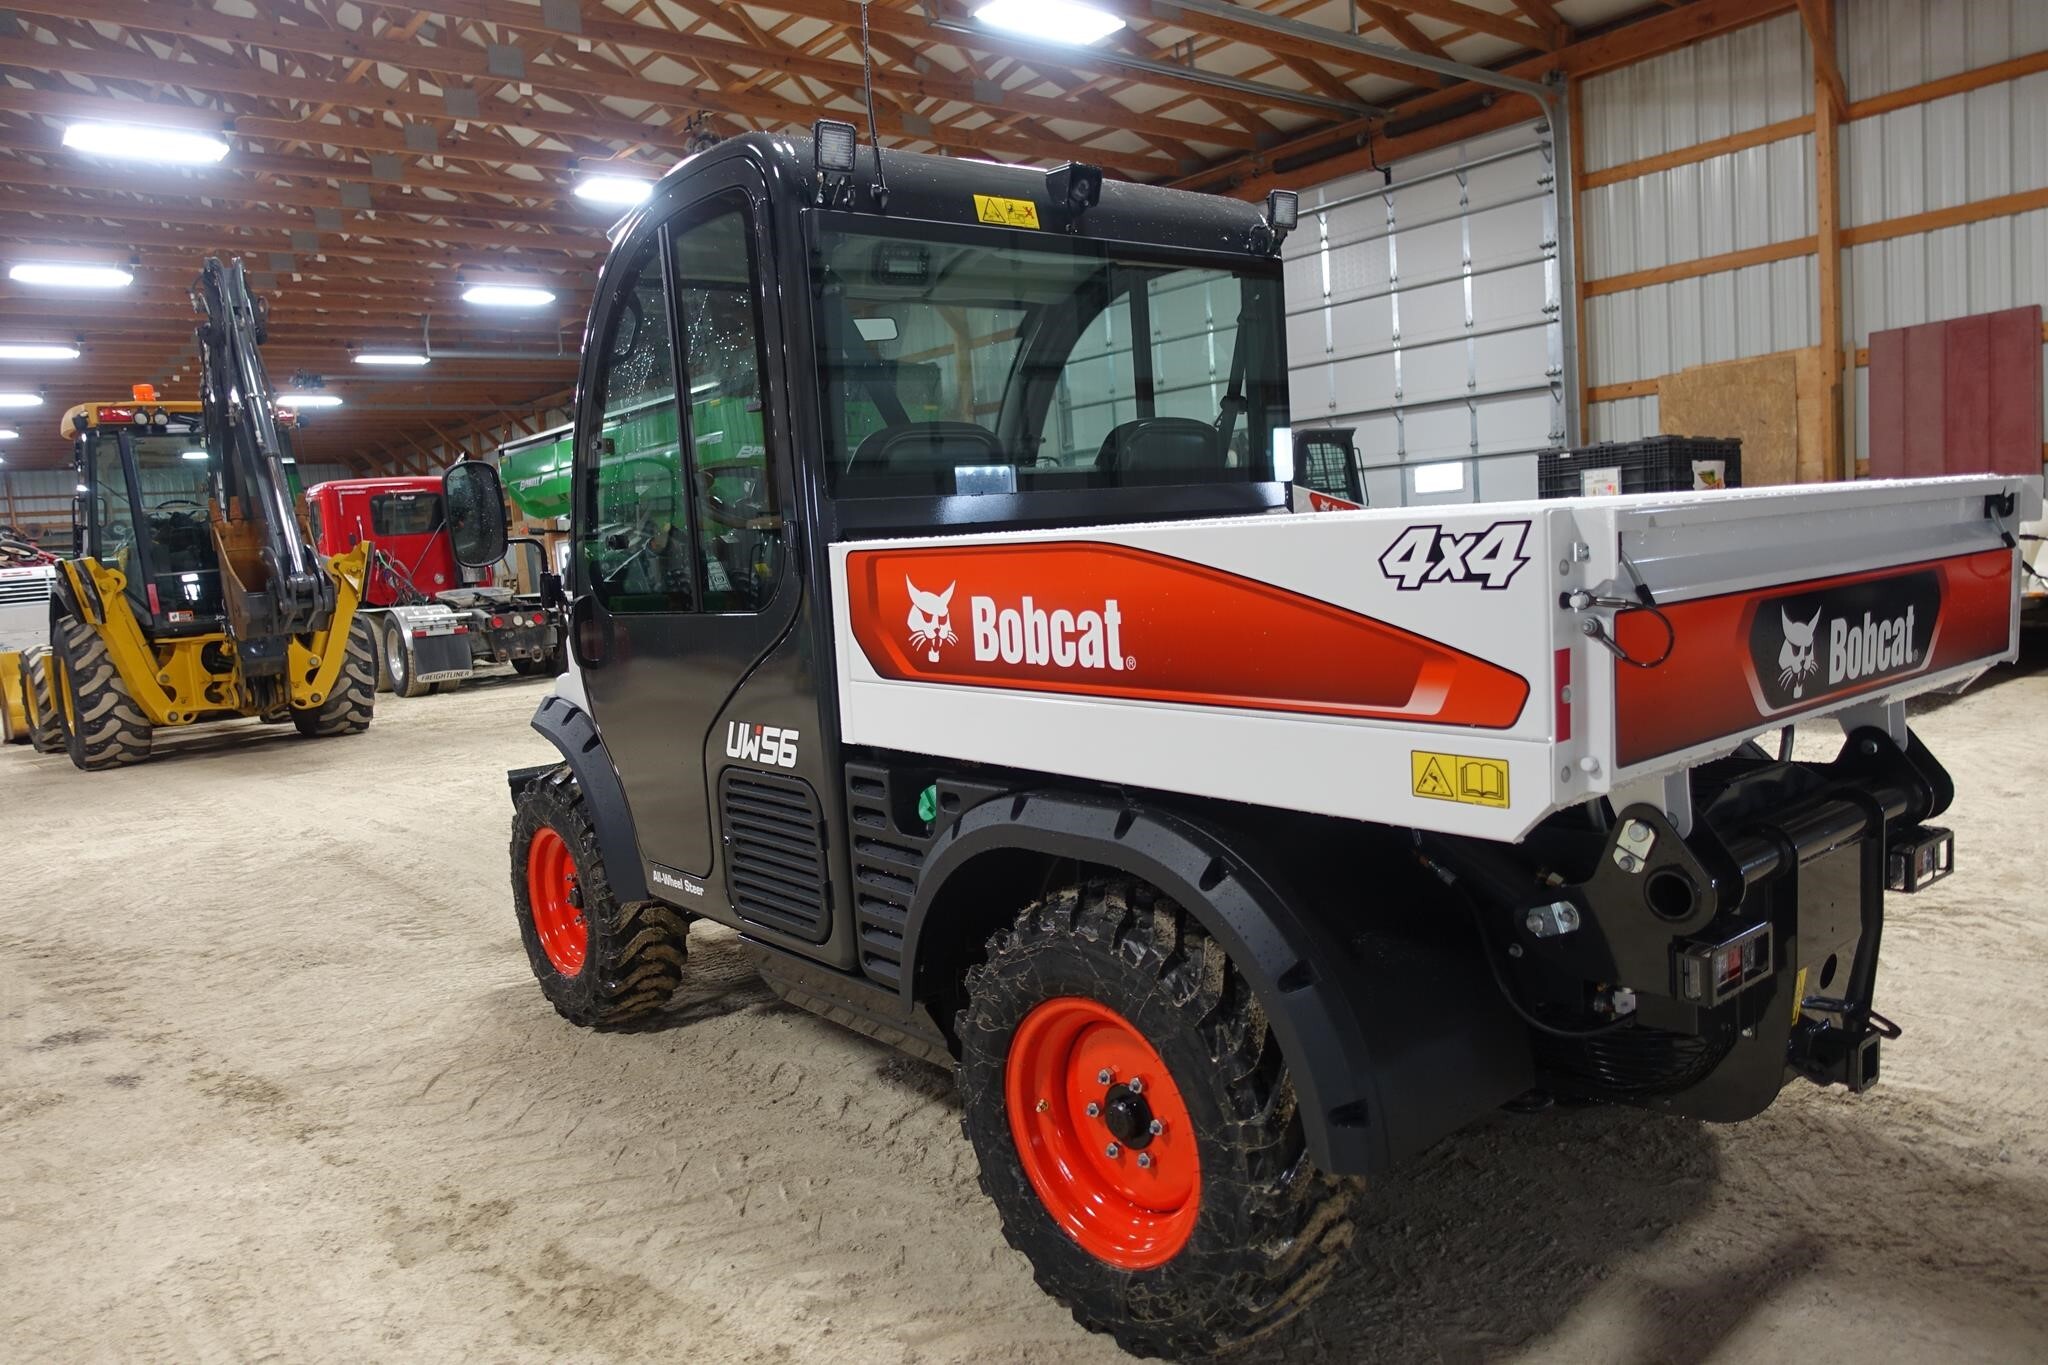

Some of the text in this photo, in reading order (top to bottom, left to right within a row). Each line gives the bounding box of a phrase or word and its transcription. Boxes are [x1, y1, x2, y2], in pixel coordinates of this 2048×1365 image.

[1378, 520, 1532, 591] 4x4
[421, 671, 470, 681] FREIGHTLINER
[653, 870, 705, 896] All-Wheel Steer
